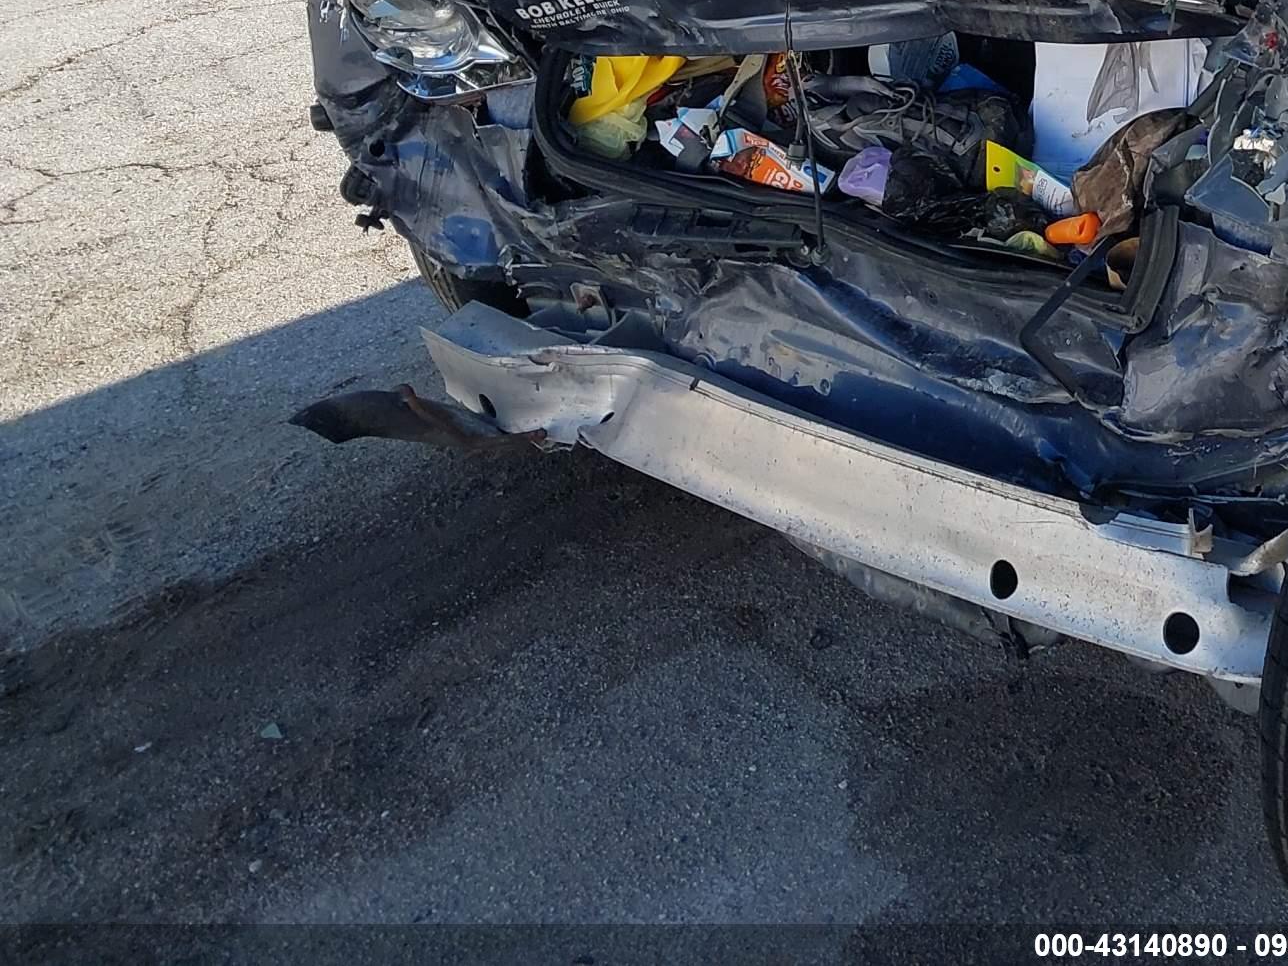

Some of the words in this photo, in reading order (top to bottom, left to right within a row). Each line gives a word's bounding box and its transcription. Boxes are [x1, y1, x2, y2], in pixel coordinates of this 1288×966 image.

[515, 1, 556, 20] BOB
[533, 6, 587, 24] CHEVROLET
[592, 0, 621, 10] BUICK
[610, 6, 631, 14] OHIO
